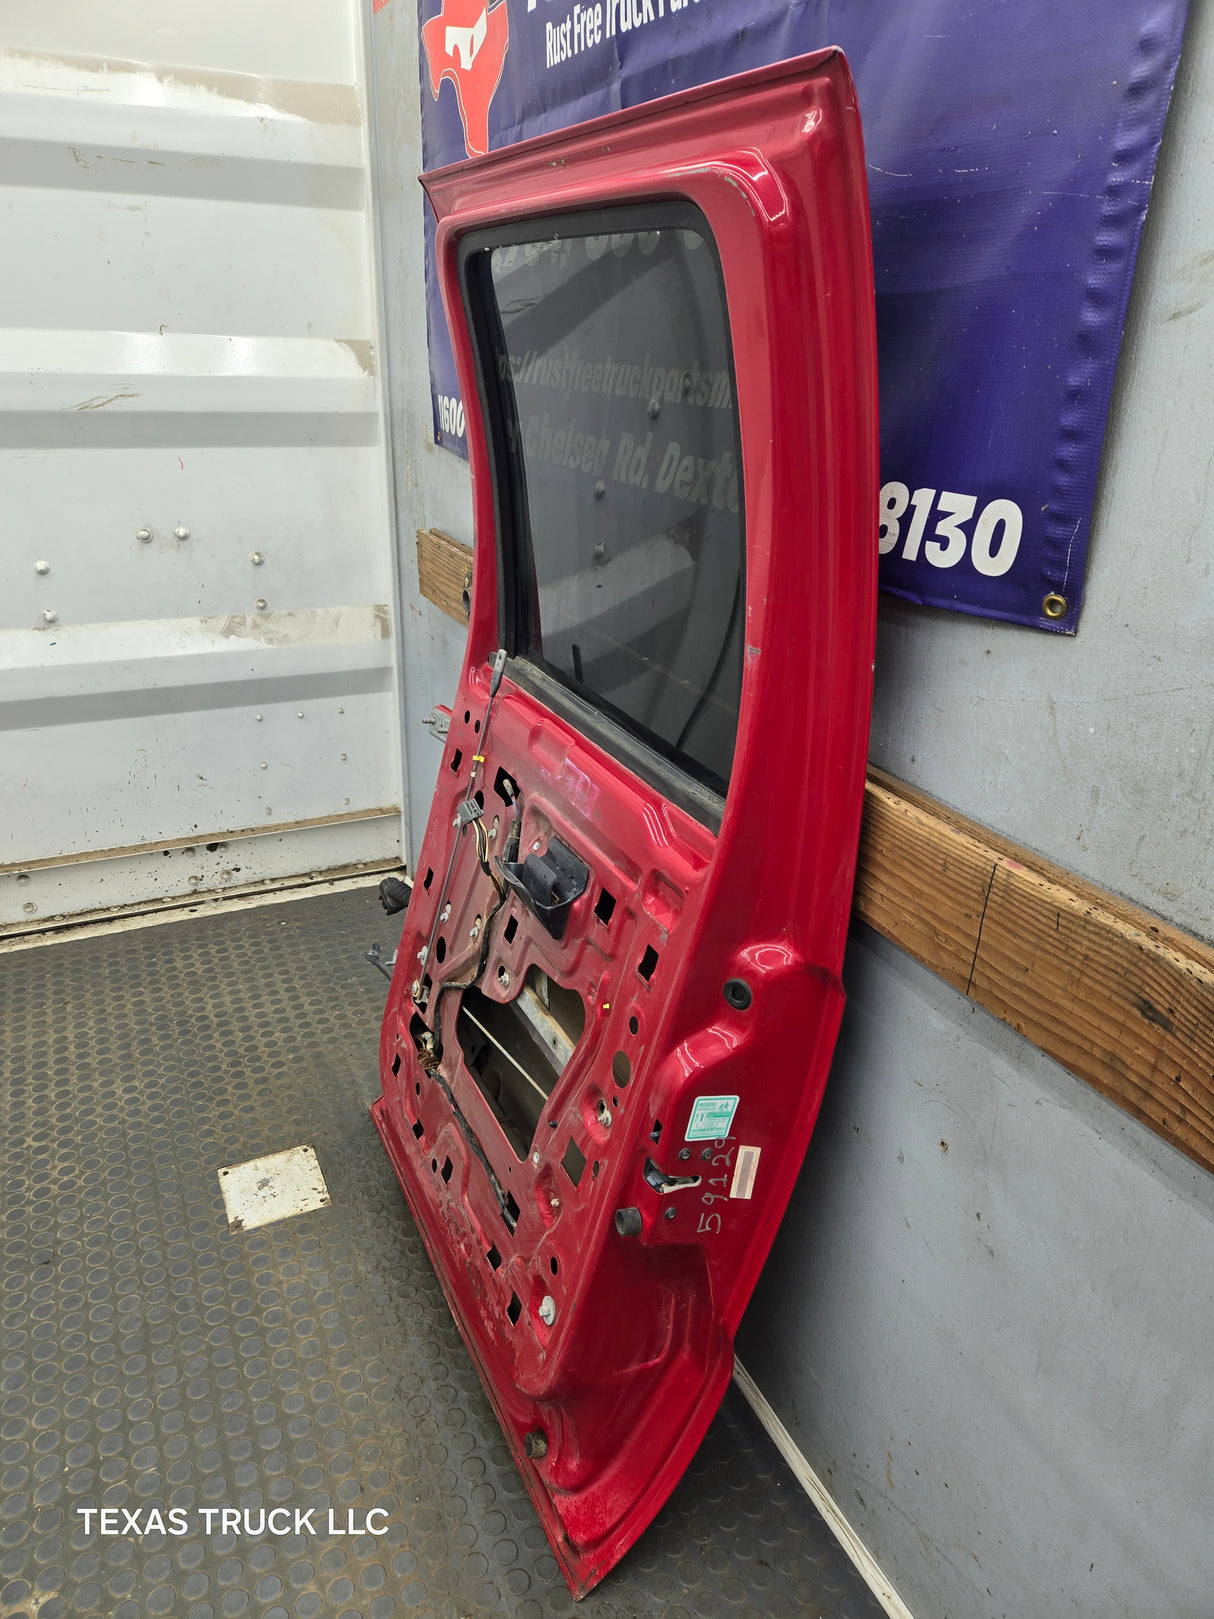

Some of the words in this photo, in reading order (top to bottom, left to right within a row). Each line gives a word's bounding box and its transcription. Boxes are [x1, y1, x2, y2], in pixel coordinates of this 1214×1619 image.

[546, 14, 572, 68] Rust
[573, 3, 602, 55] Free
[525, 413, 611, 475] Chelsea
[612, 432, 654, 489] Rd.
[879, 481, 1023, 577] 8130
